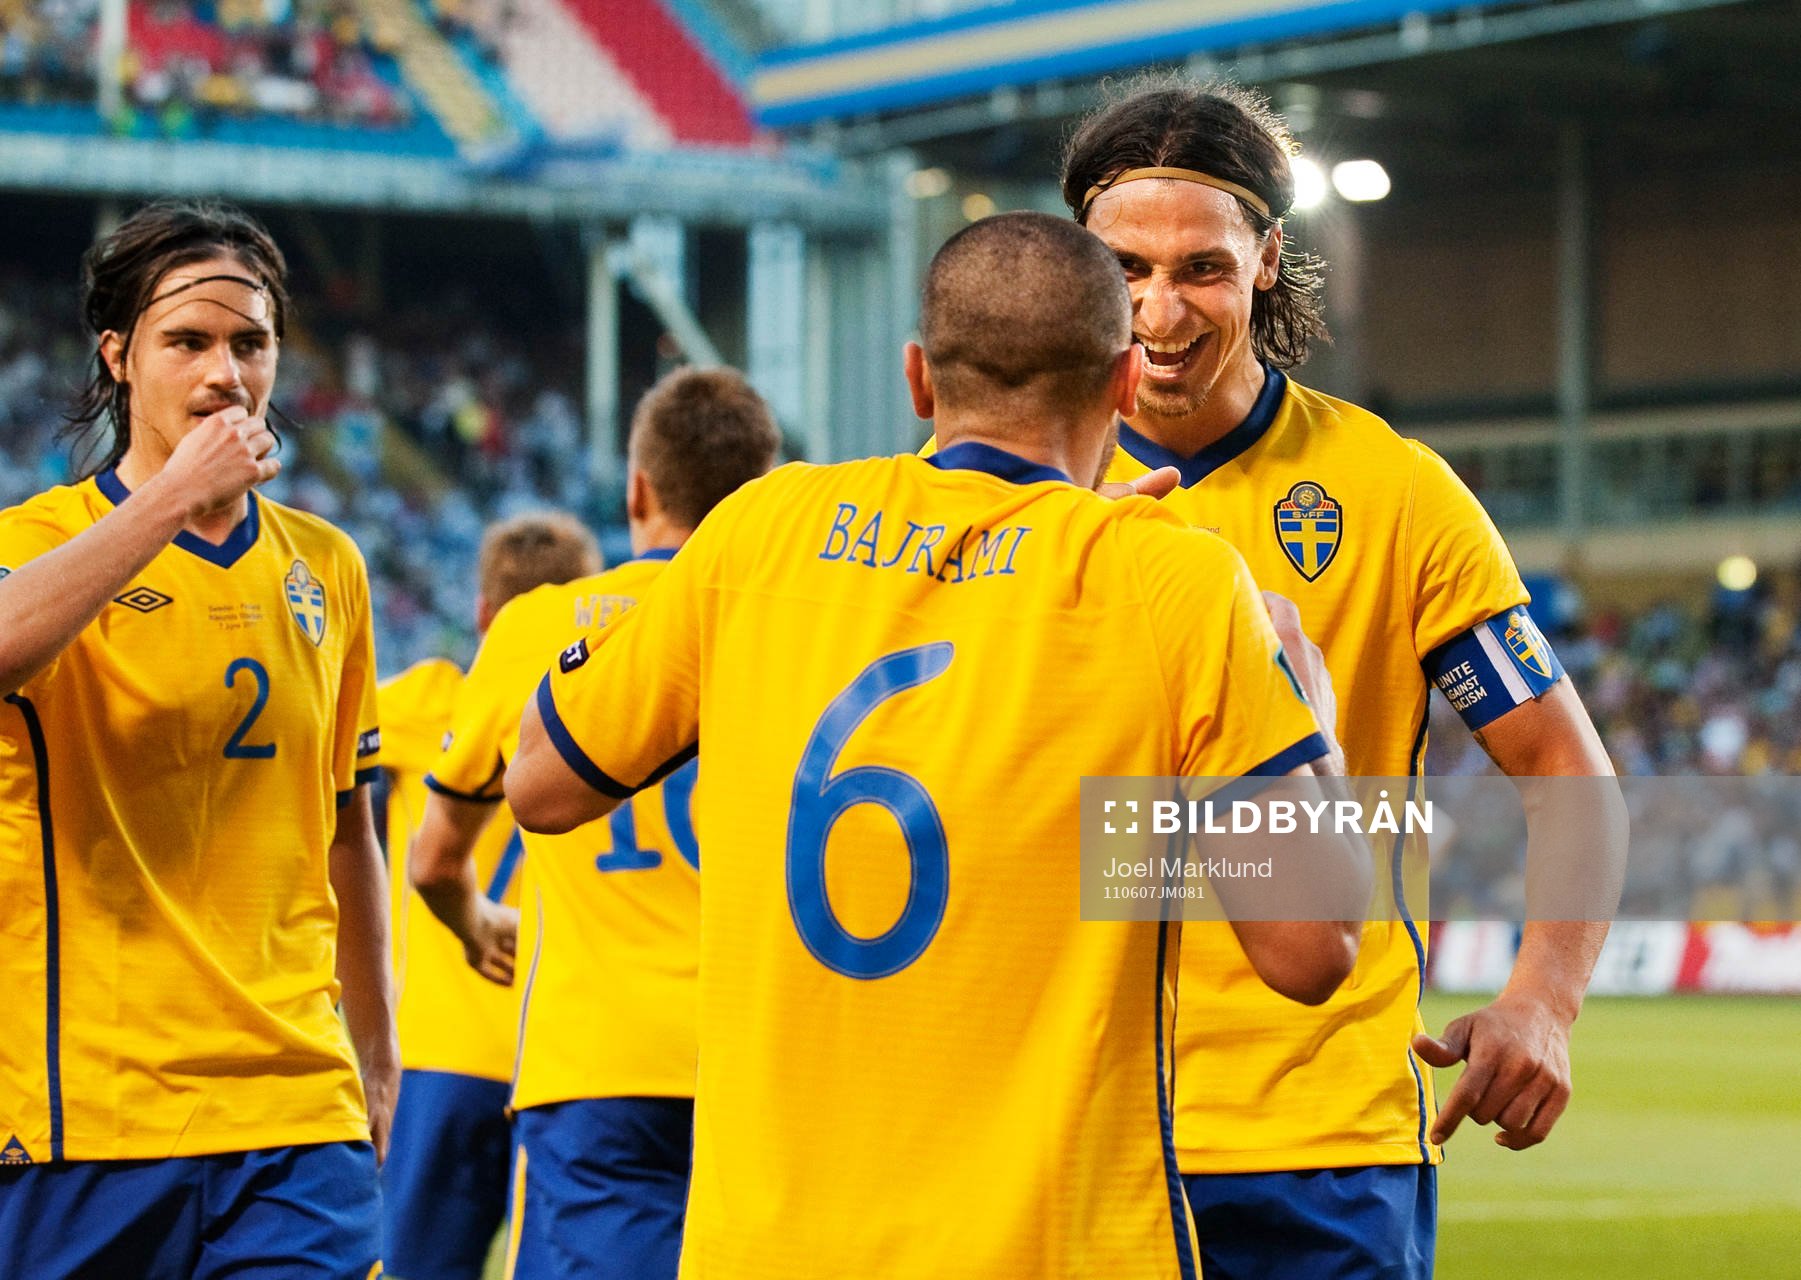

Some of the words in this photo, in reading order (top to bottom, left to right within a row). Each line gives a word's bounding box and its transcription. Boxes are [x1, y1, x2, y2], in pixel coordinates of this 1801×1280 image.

[818, 503, 1032, 583] BAJRAMI
[223, 657, 277, 759] 2
[1438, 661, 1474, 688] UNITE
[1446, 675, 1479, 700] GAINST
[786, 641, 954, 980] 6
